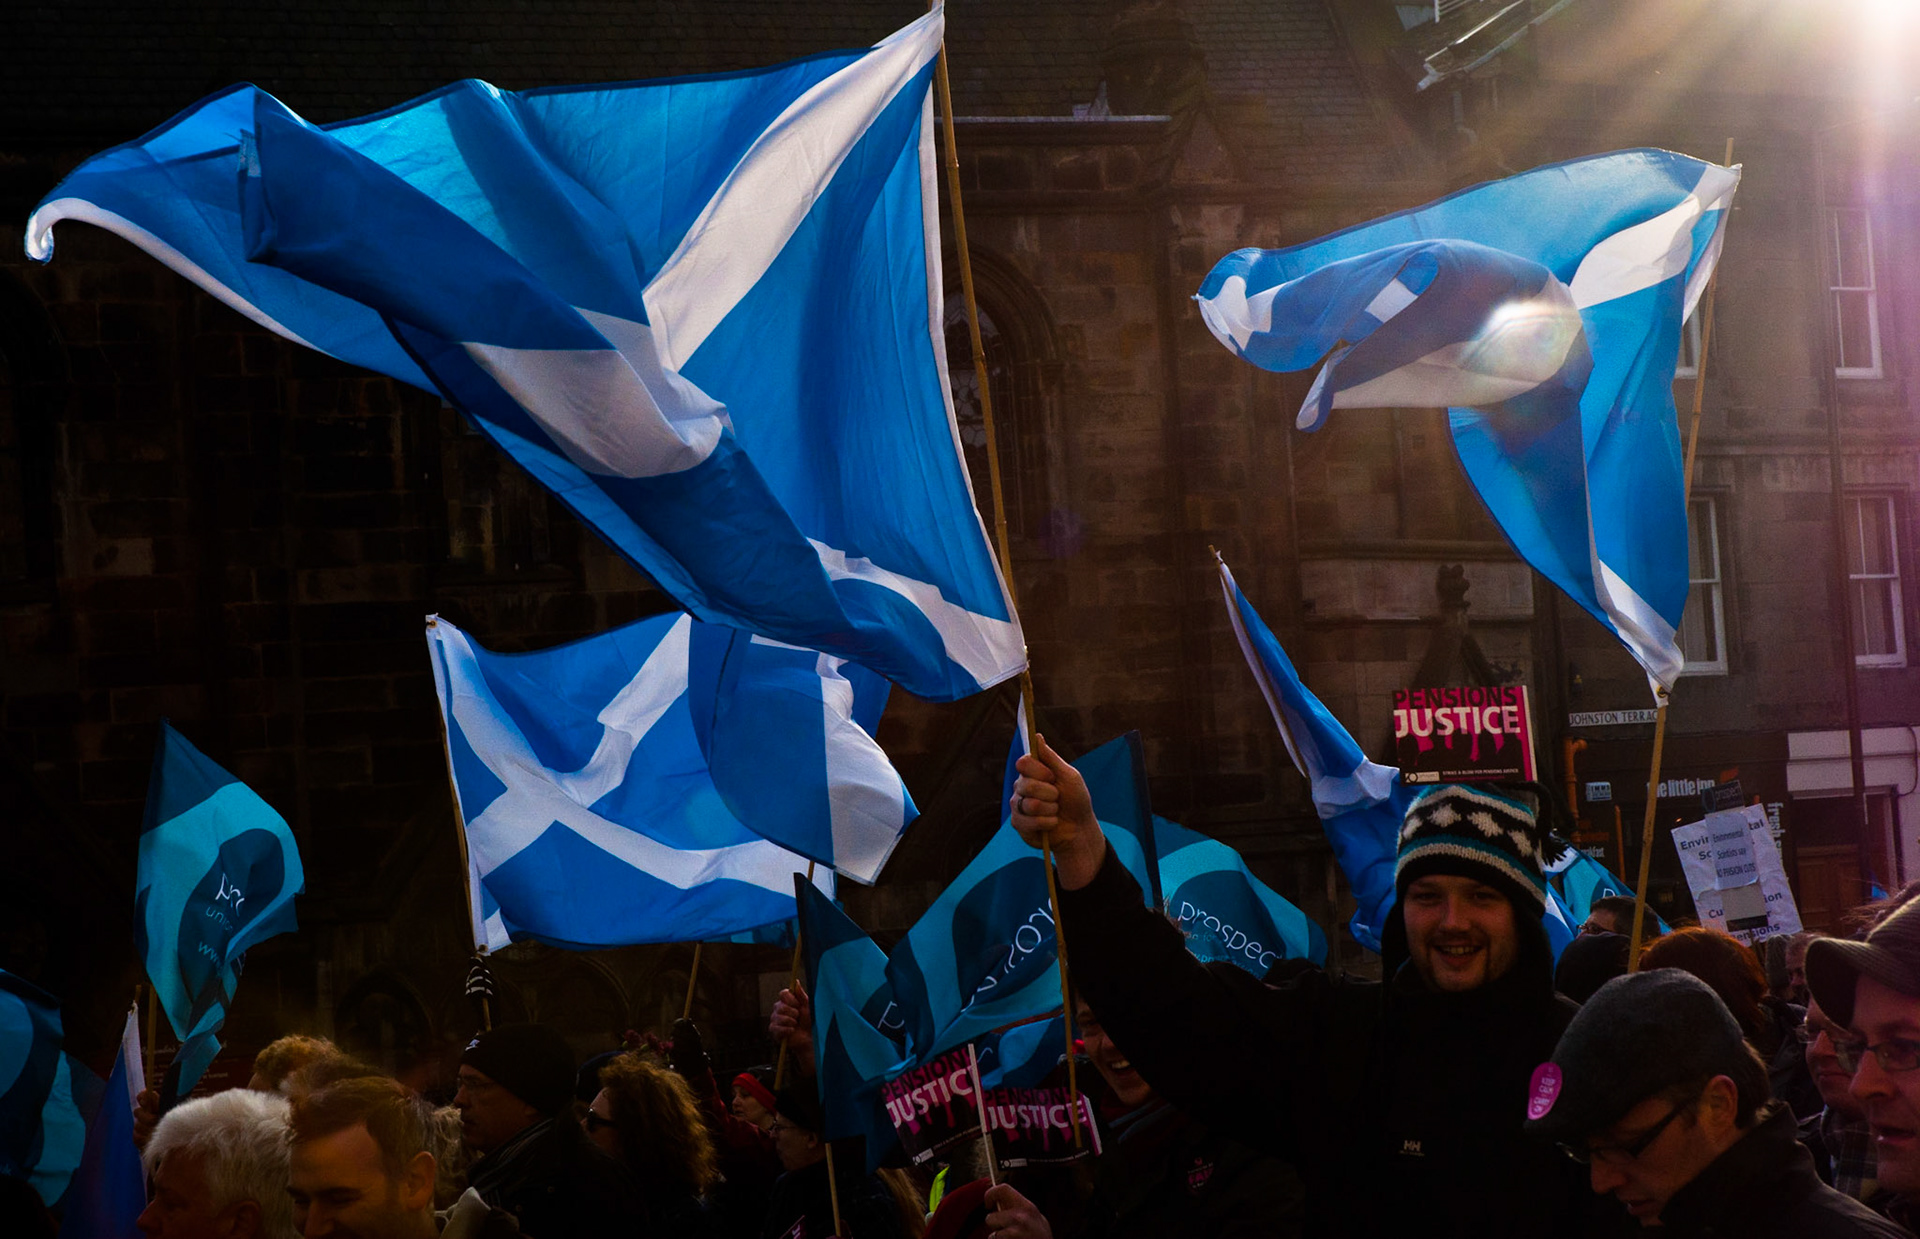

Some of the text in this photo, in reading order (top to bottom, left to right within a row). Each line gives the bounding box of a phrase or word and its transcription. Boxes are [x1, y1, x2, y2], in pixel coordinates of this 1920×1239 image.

[1393, 687, 1518, 710] PENSIONS
[1393, 706, 1521, 738] JUSTICE
[1569, 710, 1658, 725] JOHNSTON TERRAC
[1668, 778, 1697, 798] little
[1178, 901, 1282, 969] prospec
[1733, 923, 1780, 942] ensions
[880, 1047, 971, 1097] PENSION
[983, 1087, 1071, 1108] PENSION
[987, 1101, 1087, 1130] JUSTICE
